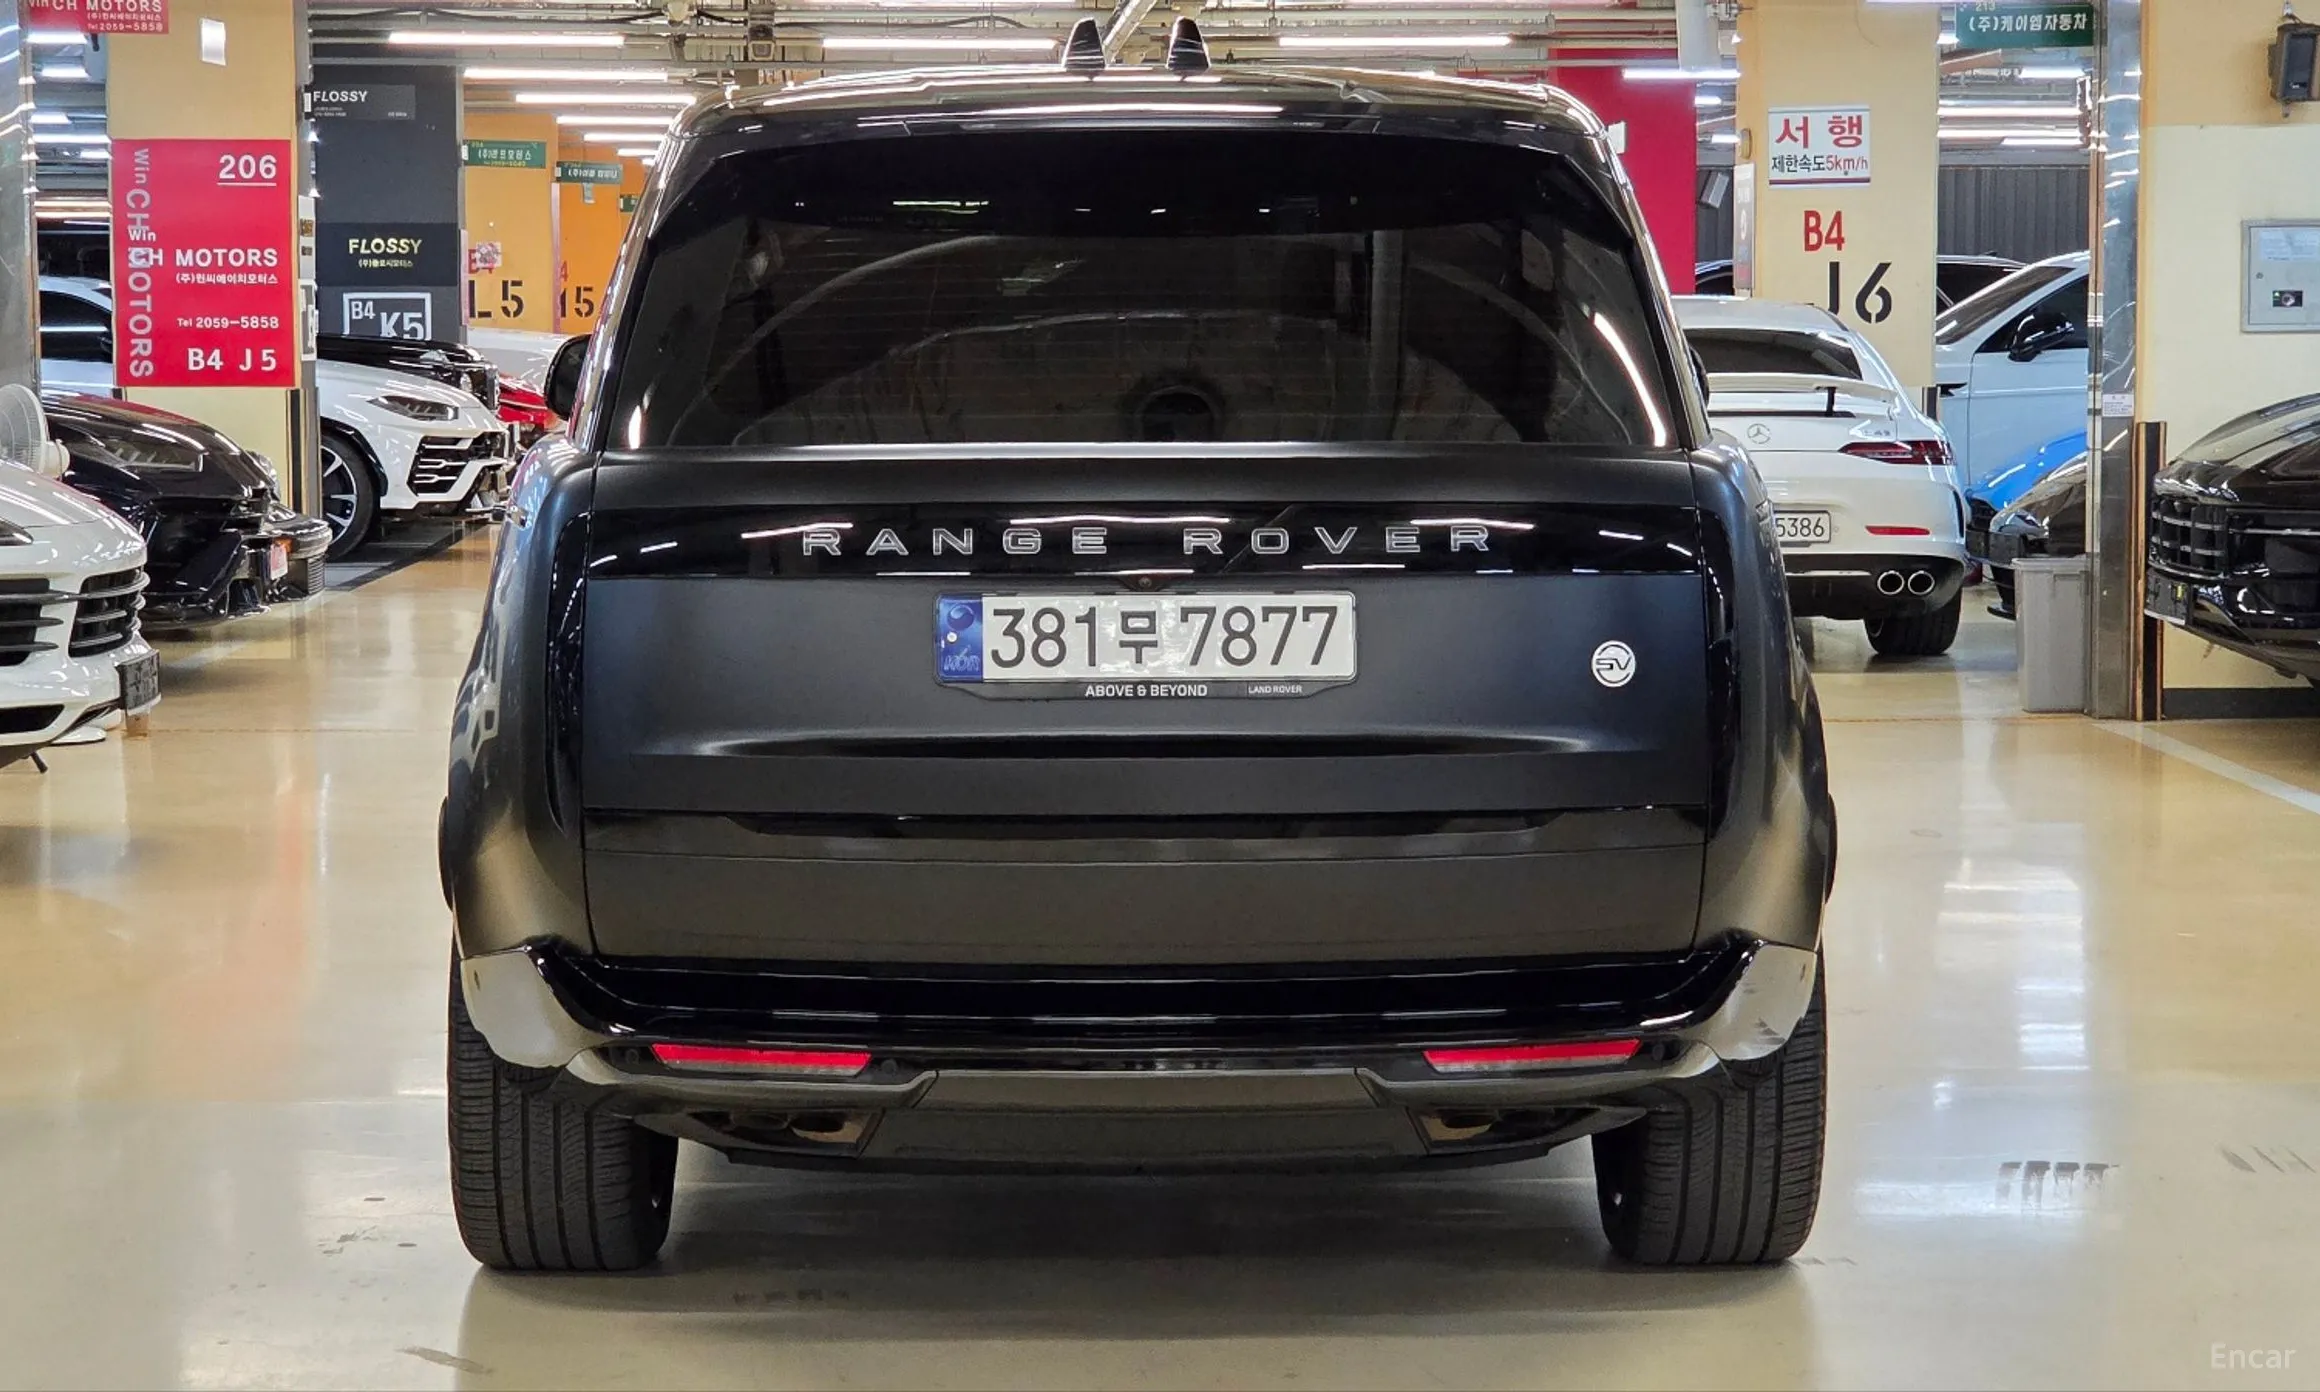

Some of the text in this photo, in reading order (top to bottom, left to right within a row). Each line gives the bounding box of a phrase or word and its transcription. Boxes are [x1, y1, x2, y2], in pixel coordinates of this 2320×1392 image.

[86, 0, 163, 12] MOTORS
[1969, 13, 2087, 32] (주)케이엠자동차
[313, 90, 368, 103] FLOSSY
[218, 154, 278, 180] 206
[128, 227, 157, 242] Win
[1803, 210, 1846, 252] B4
[348, 237, 423, 255] FLOSSY
[176, 248, 279, 268] MOTORS
[351, 300, 377, 320] B4
[177, 315, 280, 329] Tel 2059-5858
[380, 311, 425, 341] K5
[187, 347, 224, 372] B4
[1774, 516, 1825, 538] 5386
[802, 525, 1490, 556] RANGE ROVER
[1084, 684, 1208, 698] ABOVE & BEYOND
[1247, 685, 1303, 695] LAND ROVER
